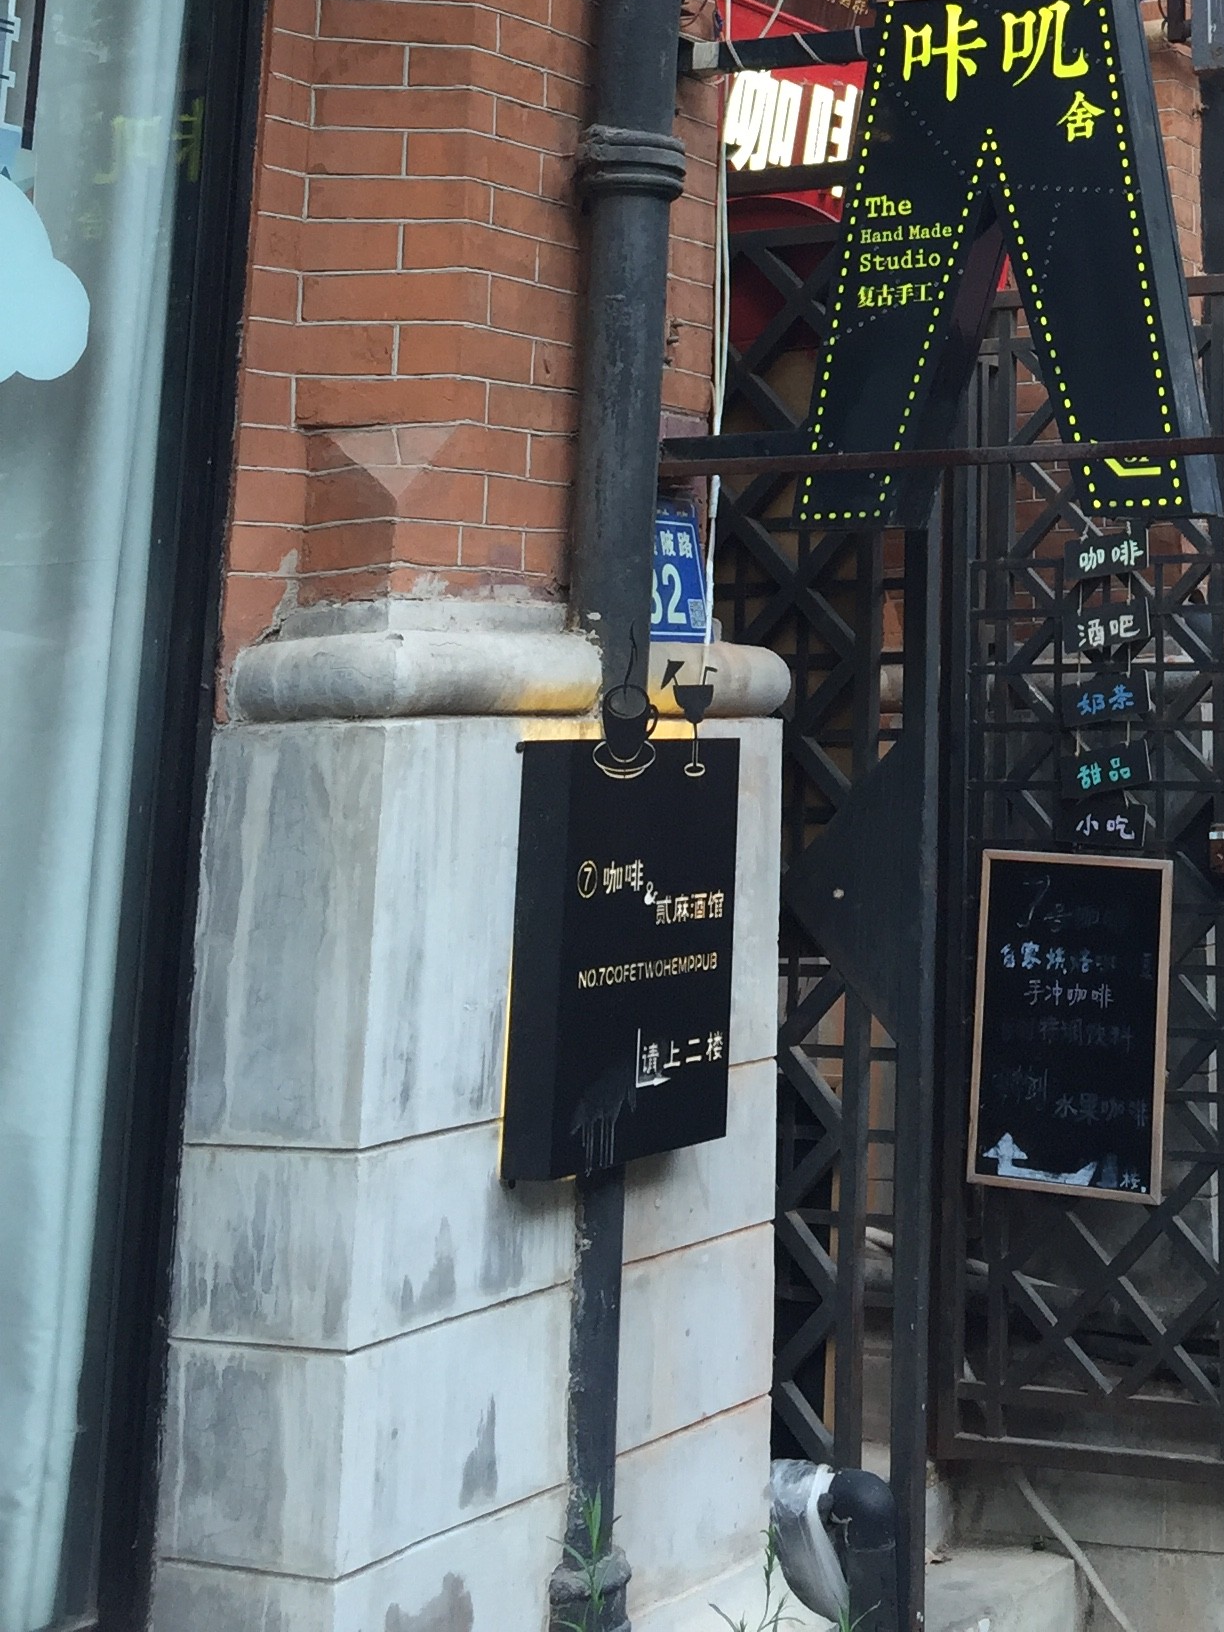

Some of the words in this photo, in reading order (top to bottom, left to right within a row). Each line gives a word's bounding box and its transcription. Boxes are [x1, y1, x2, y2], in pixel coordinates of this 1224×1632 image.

[865, 195, 912, 218] The
[860, 225, 904, 244] Hand
[908, 222, 953, 240] Made
[859, 248, 941, 273] Studio
[857, 281, 933, 308] 复古手工
[654, 529, 693, 559] 陂路
[1079, 538, 1144, 572] 咖啡
[1078, 614, 1141, 648] 酒吧
[1077, 684, 1134, 716] 奶茶
[1077, 757, 1132, 790] 甜品
[1076, 813, 1134, 841] 小吃
[1024, 979, 1115, 1010] 手冲咖啡
[641, 1031, 724, 1074] 请上二楼
